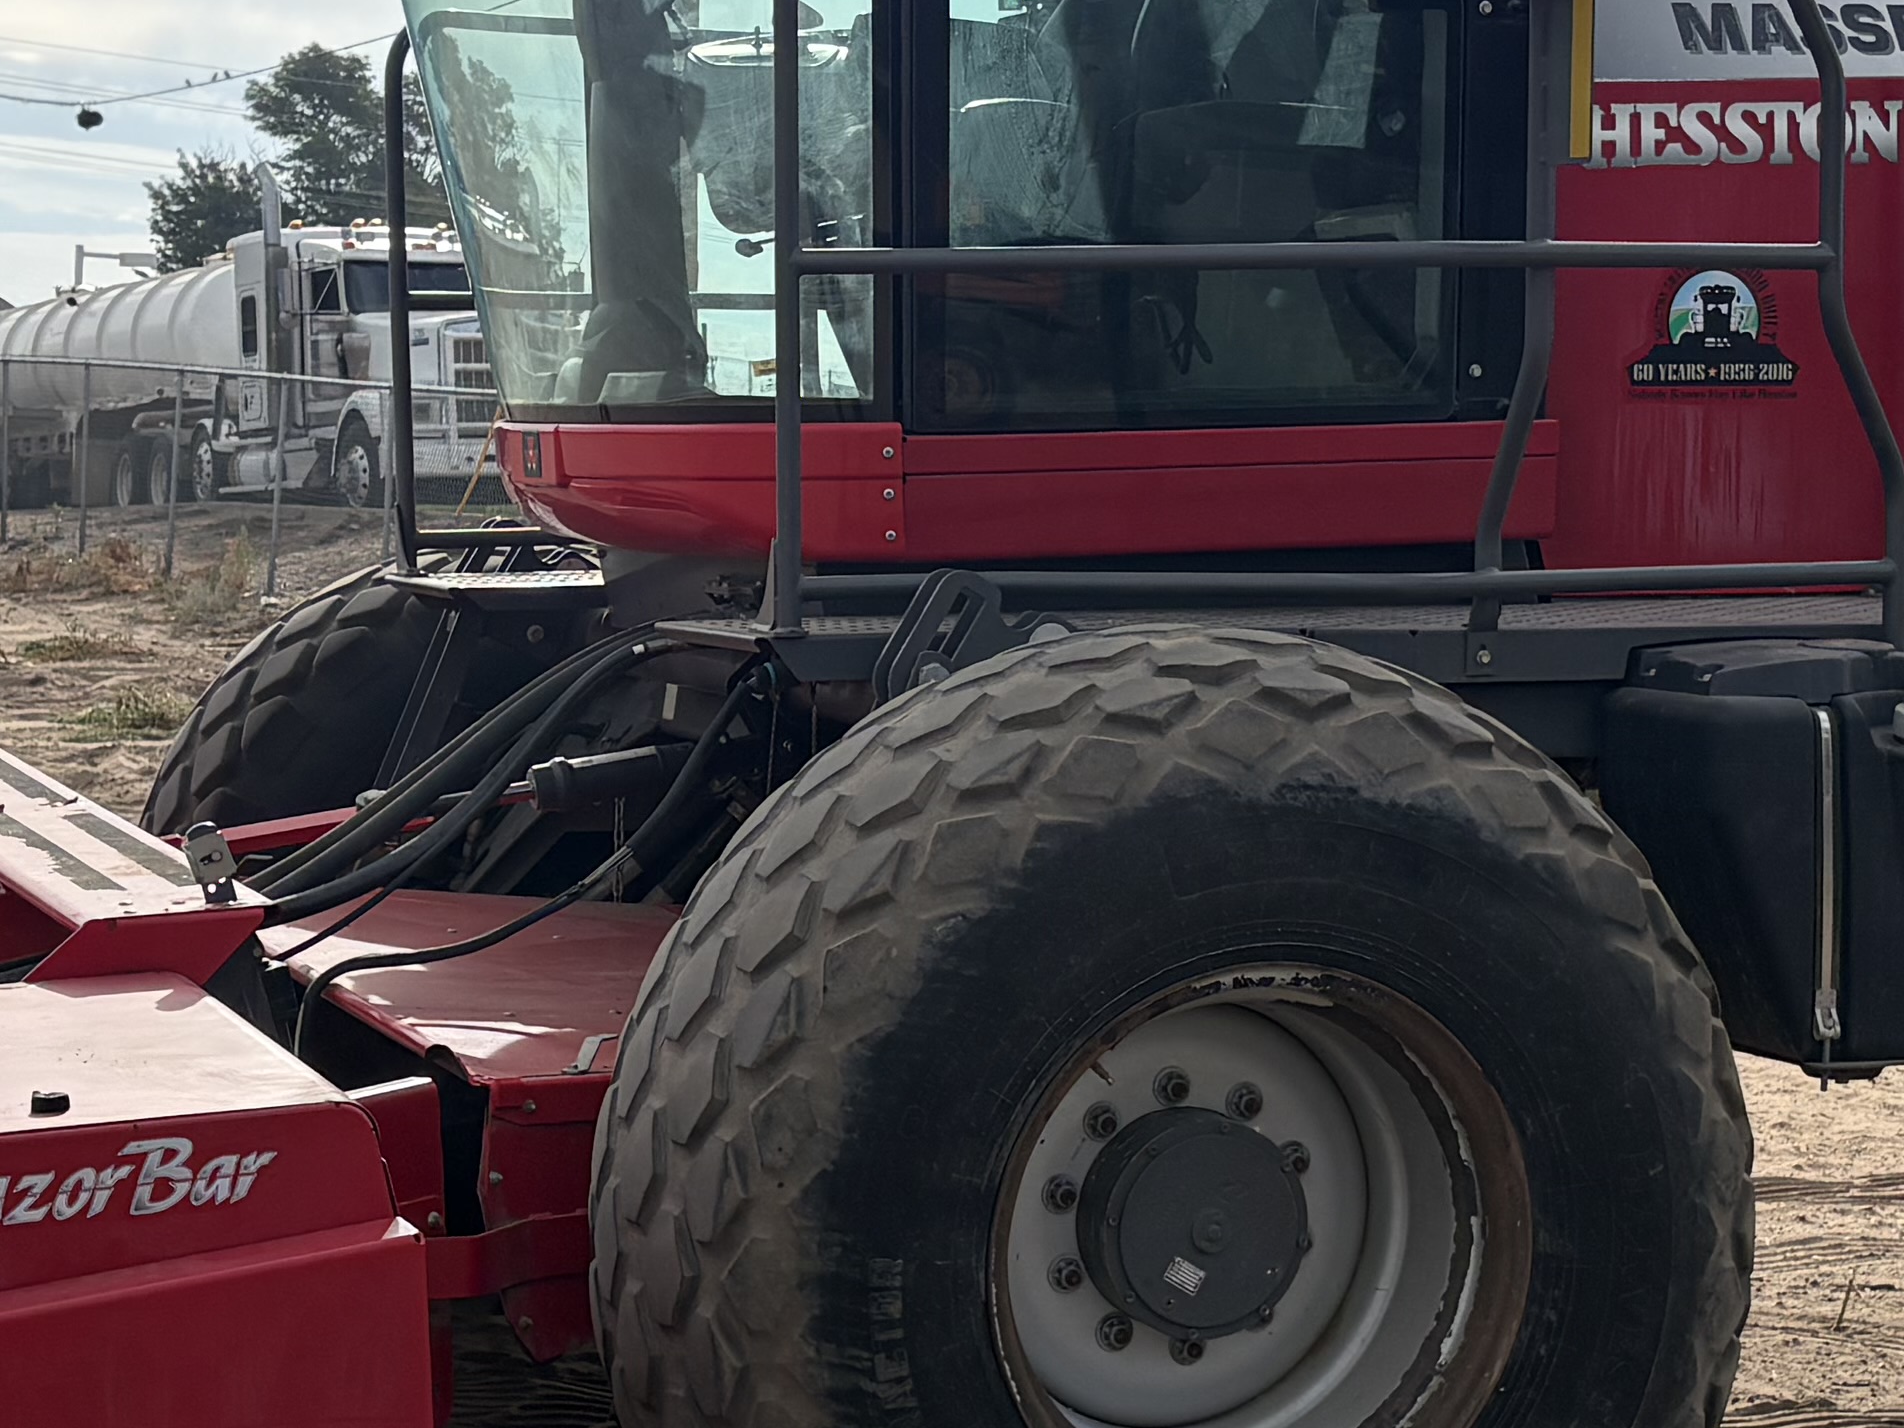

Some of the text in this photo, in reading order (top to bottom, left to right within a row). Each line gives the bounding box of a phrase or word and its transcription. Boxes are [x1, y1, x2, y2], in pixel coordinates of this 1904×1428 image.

[1633, 362, 1793, 382] 60 YEARS 1956-2016
